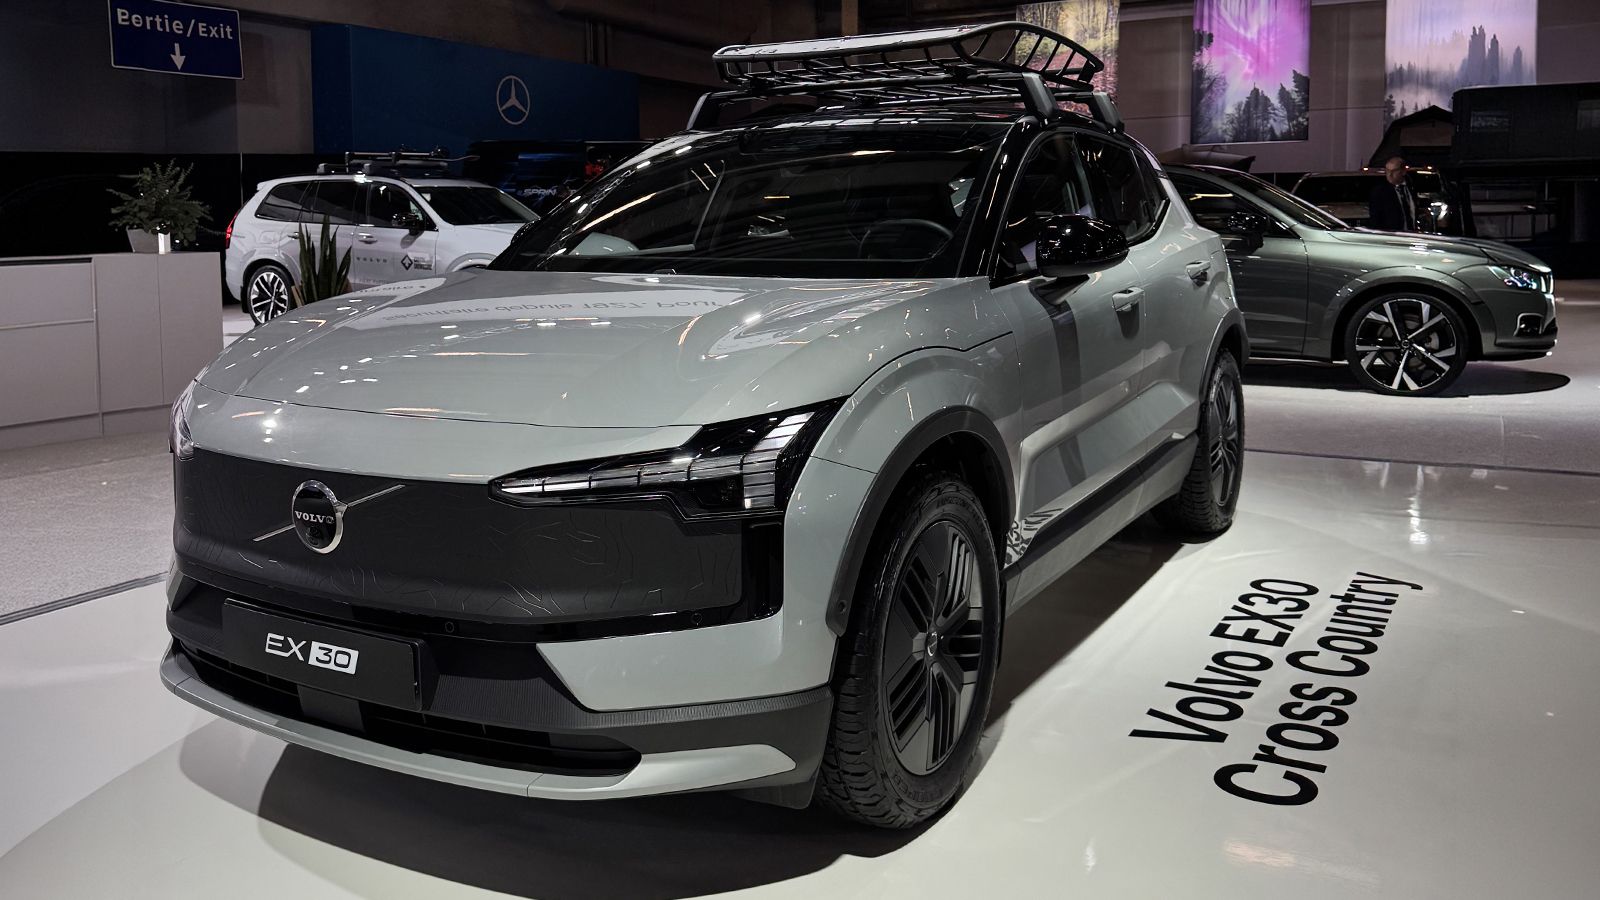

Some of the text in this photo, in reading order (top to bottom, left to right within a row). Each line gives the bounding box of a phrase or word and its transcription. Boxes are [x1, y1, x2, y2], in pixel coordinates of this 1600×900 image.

[294, 510, 335, 525] VOLVO
[1128, 578, 1319, 743] Volvo EX30
[1213, 571, 1423, 806] Cross Country
